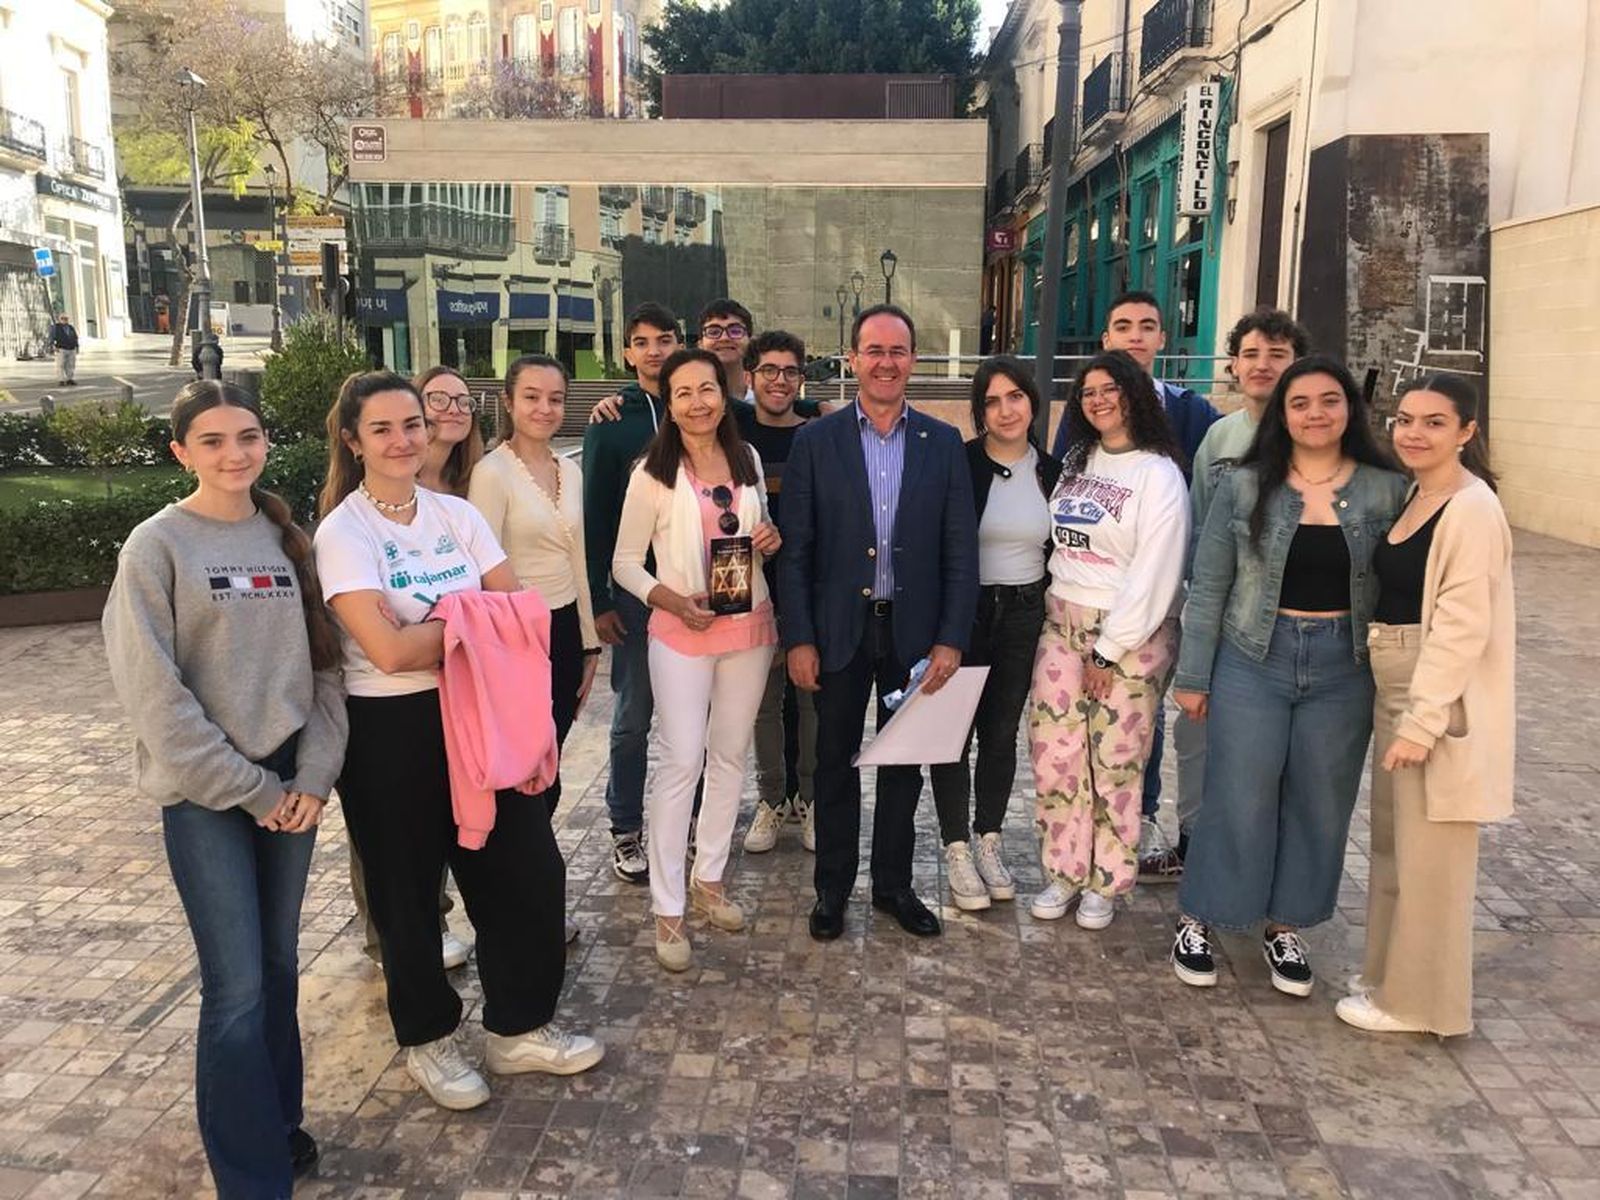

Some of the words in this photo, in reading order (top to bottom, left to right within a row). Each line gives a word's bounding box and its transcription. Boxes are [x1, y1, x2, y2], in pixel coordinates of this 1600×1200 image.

[1200, 86, 1212, 96] EL
[1193, 99, 1213, 210] RINCONCILLO
[204, 566, 243, 574] TOMMY
[414, 564, 467, 586] cajamar
